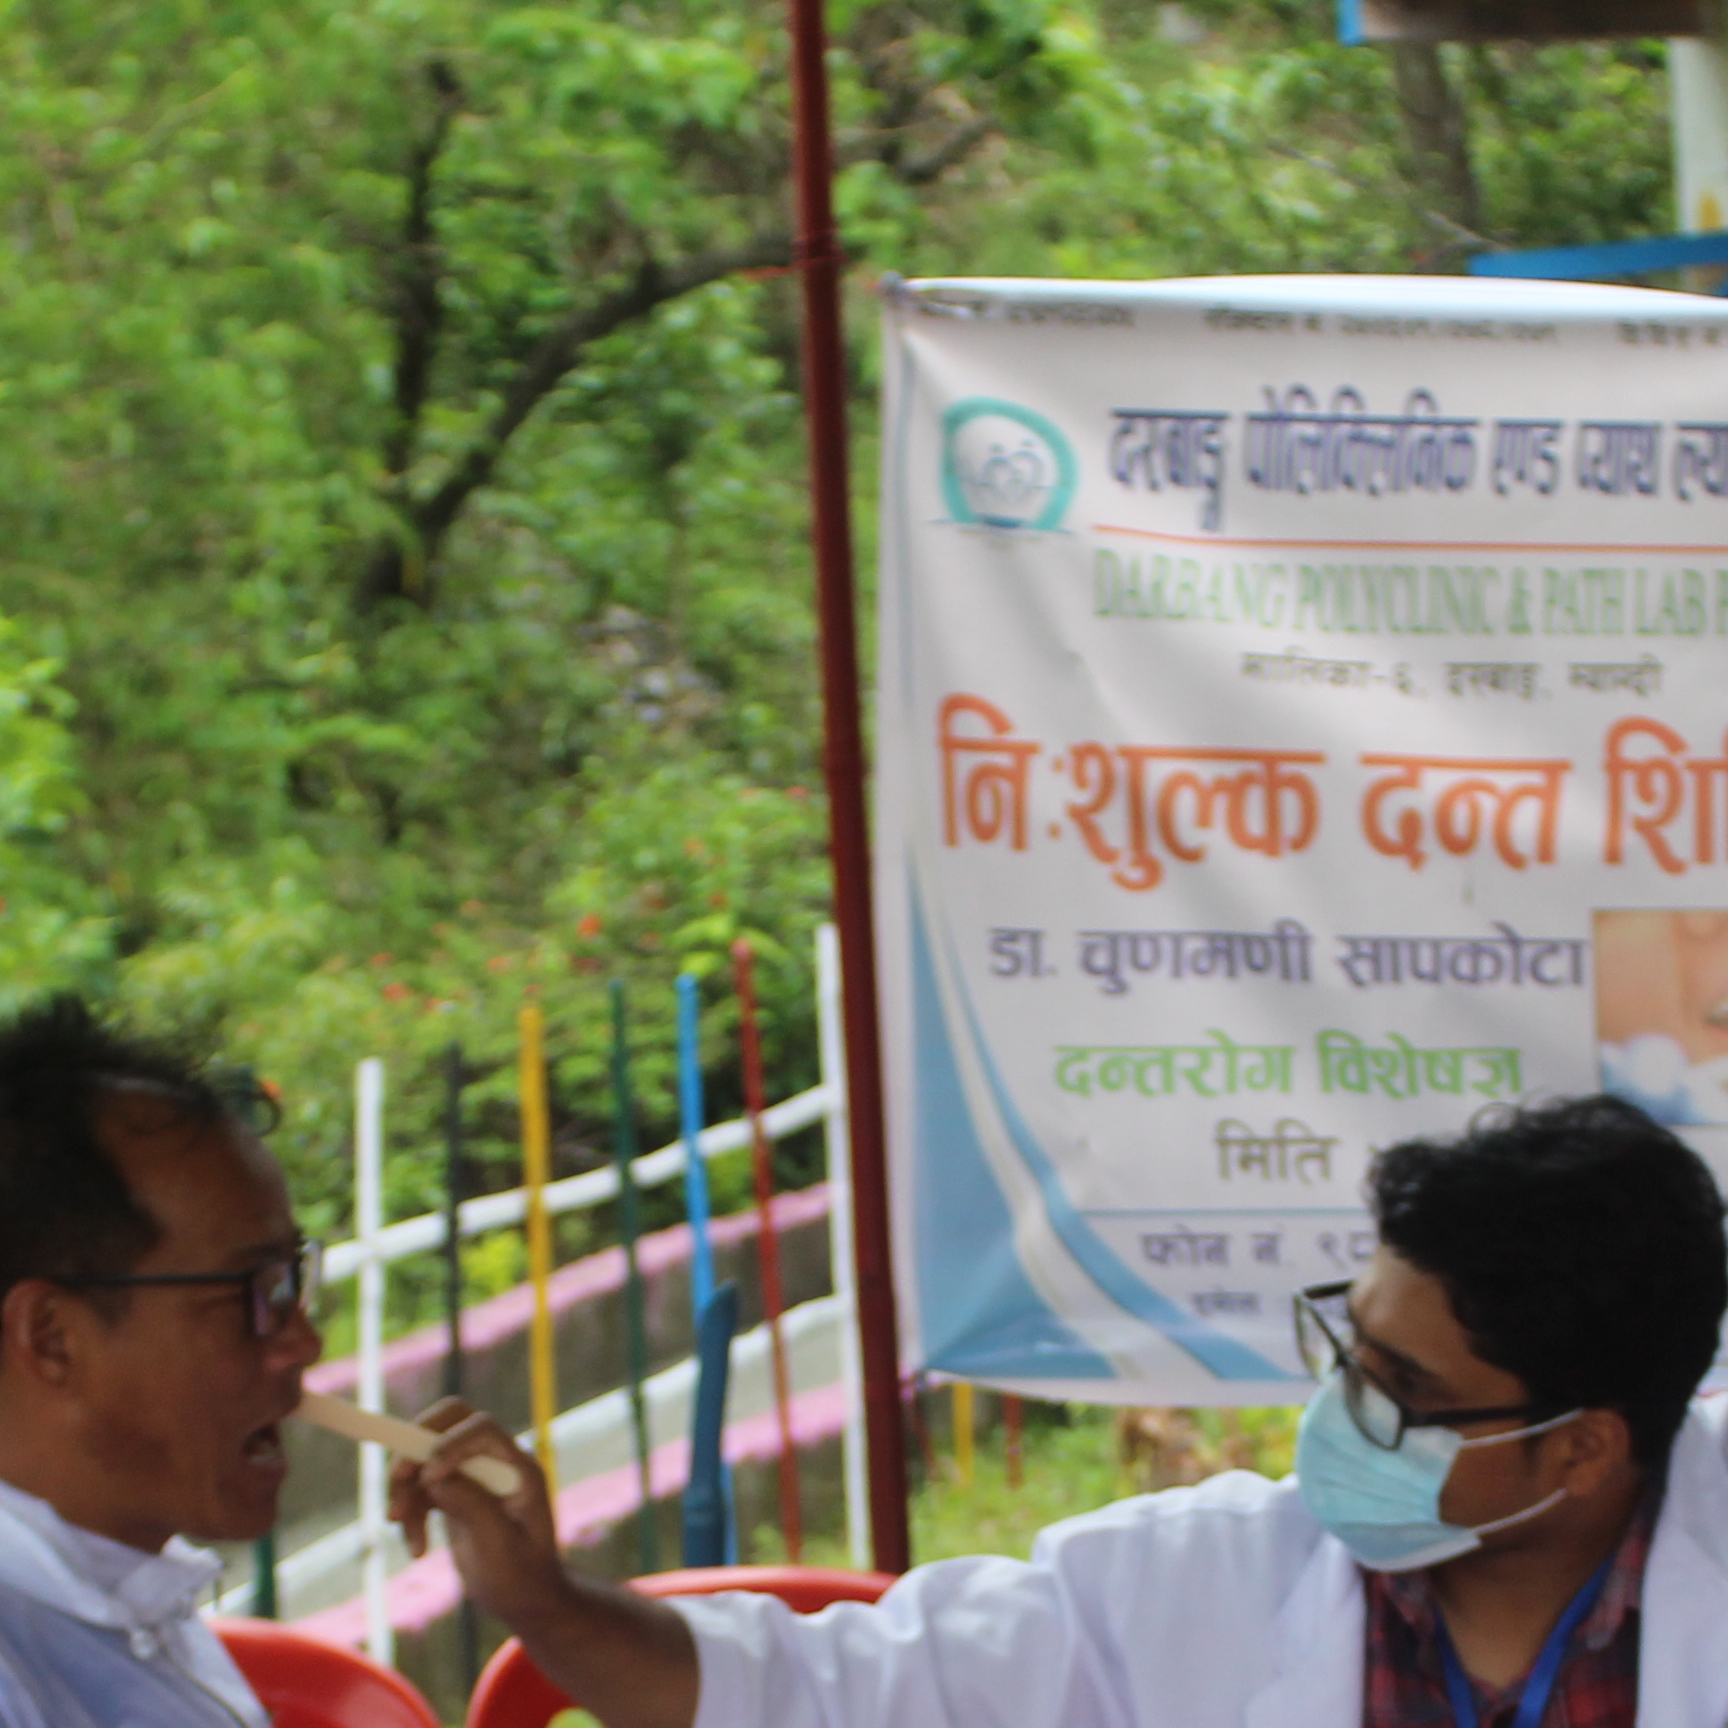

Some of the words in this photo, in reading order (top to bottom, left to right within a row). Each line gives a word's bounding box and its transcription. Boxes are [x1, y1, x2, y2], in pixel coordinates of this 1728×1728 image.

[1093, 548, 1287, 630] DARBANG
[1291, 563, 1500, 636] POLYCLINIC
[1506, 565, 1534, 636] &
[1542, 565, 1625, 637] PATH
[1633, 567, 1709, 637] LAB
[1358, 752, 1573, 872] दन्त
[987, 927, 1058, 978] डा.
[1336, 921, 1589, 987] सापकोटा
[1053, 1029, 1298, 1100] दन्तरोग
[1316, 1027, 1524, 1101] विशेषज्ञ
[1213, 1116, 1339, 1186] मिति
[1140, 1223, 1230, 1266] फोन
